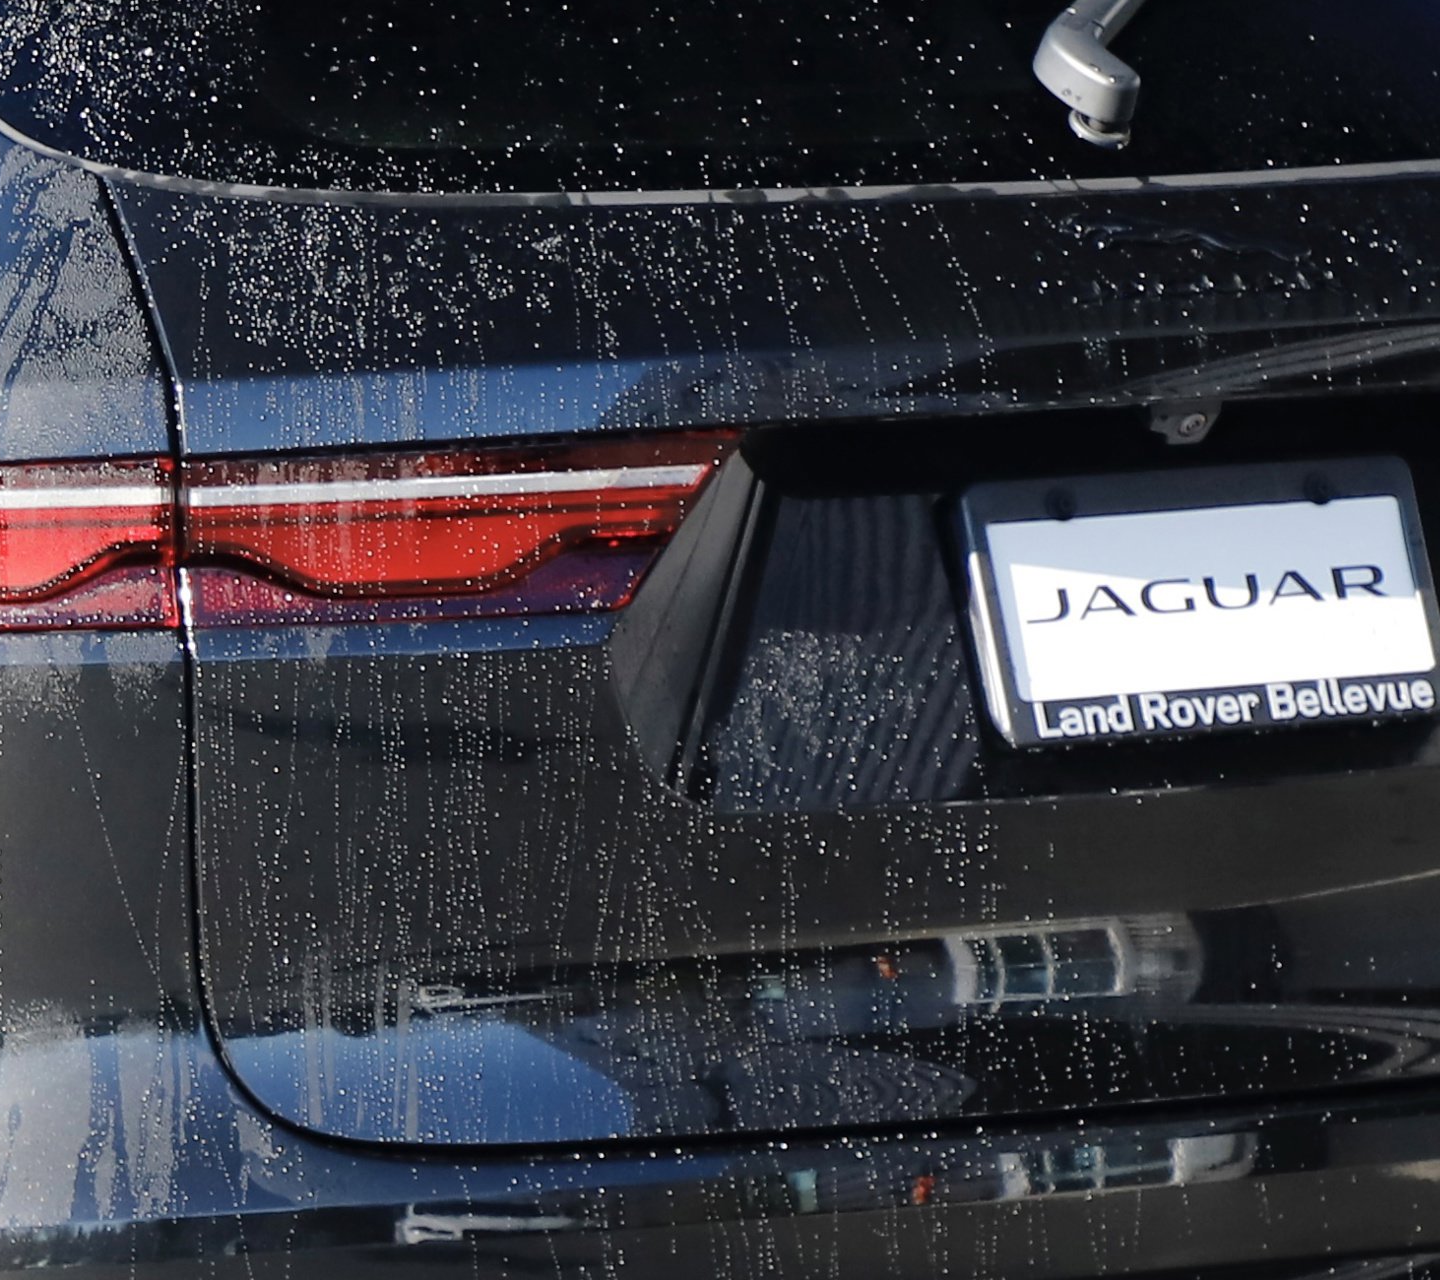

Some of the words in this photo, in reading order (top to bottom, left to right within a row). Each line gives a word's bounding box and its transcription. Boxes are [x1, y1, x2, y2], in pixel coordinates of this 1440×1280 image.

[1026, 564, 1388, 624] JAGUAR
[1032, 693, 1136, 739] Land
[1140, 691, 1260, 730] Rover
[1265, 677, 1436, 721] Bellevue
